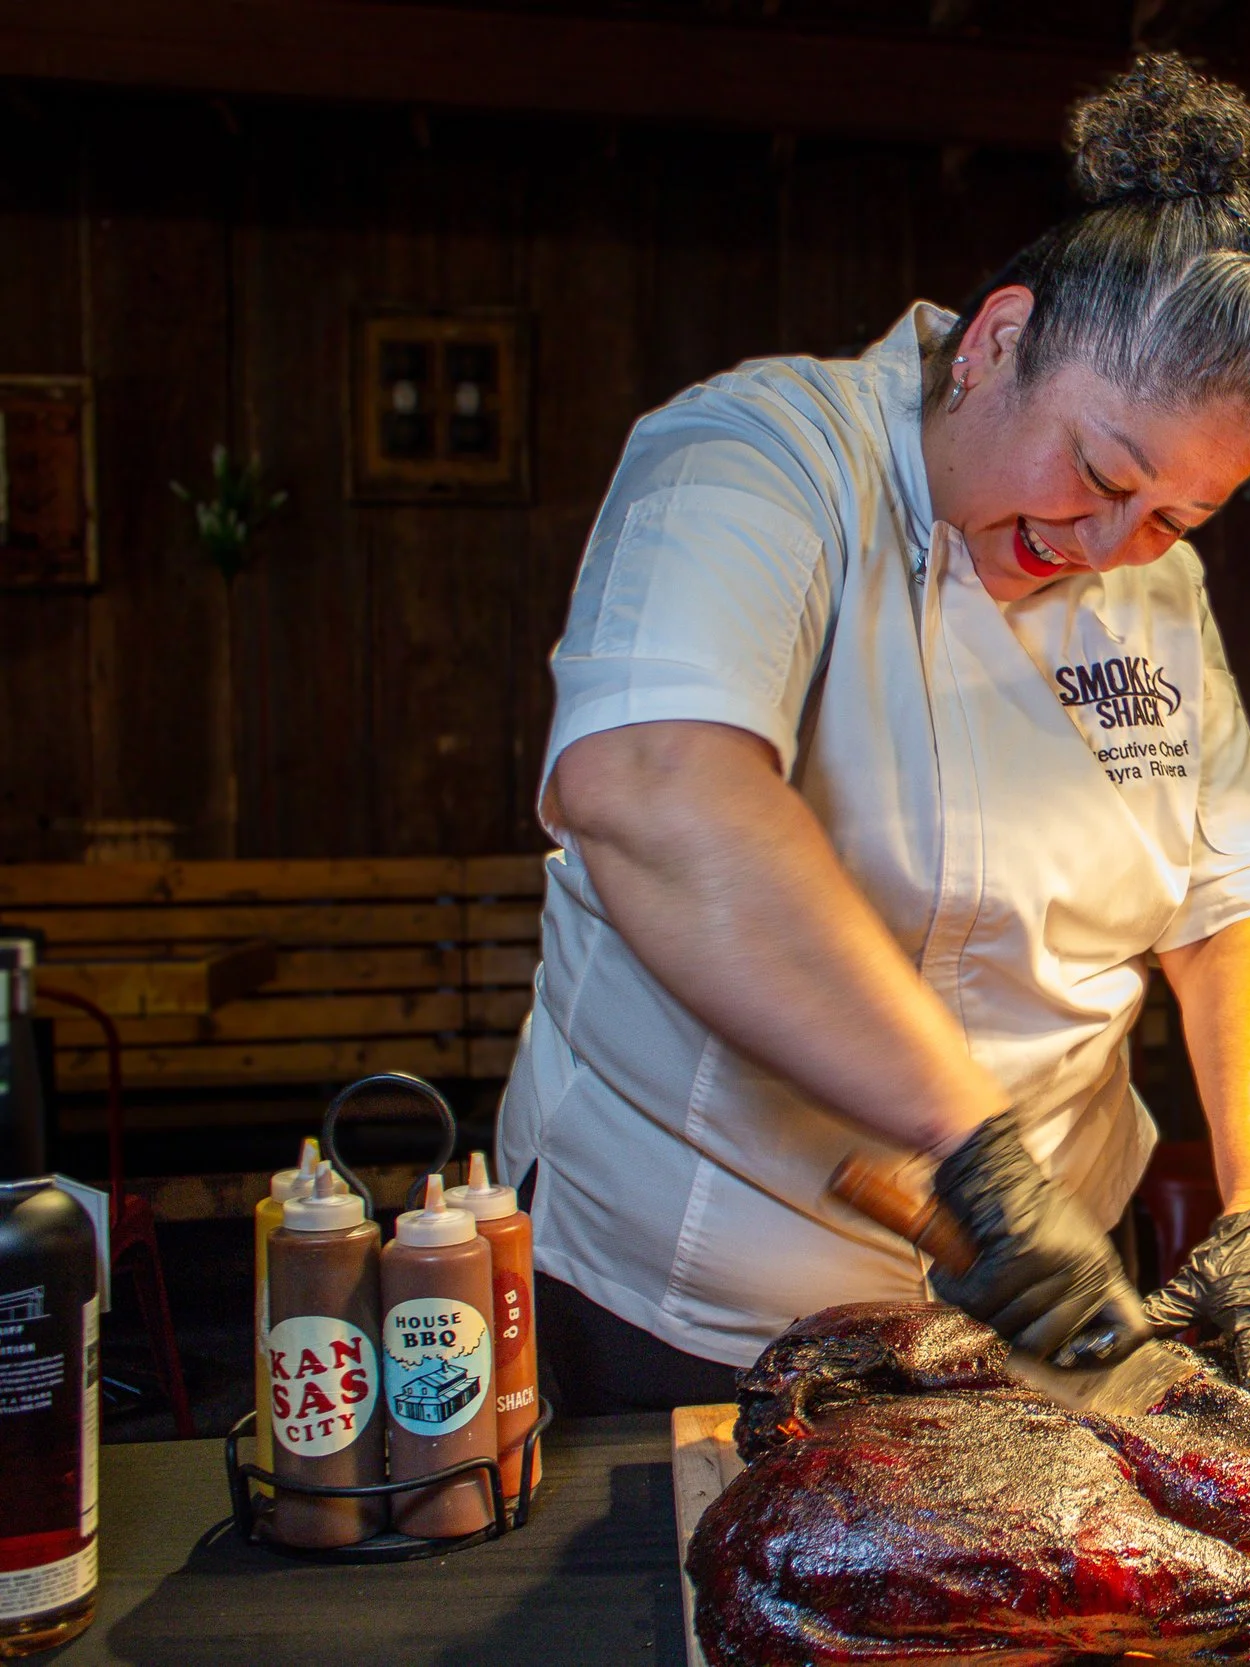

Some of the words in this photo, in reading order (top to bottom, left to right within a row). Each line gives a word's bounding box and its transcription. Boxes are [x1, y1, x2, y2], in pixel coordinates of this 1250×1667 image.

[1056, 656, 1160, 703] SMOKE
[1096, 696, 1164, 729] SHACK
[1094, 742, 1157, 762] ecutive
[1160, 740, 1189, 757] Chef
[1105, 765, 1142, 784] ayra
[1150, 760, 1187, 778] Rivera
[395, 1312, 462, 1328] HOUSE
[503, 1289, 520, 1338] BBQ
[402, 1330, 456, 1348] BBQ
[269, 1337, 362, 1380] KAN
[273, 1368, 369, 1419] SAS
[496, 1386, 534, 1413] SHACK
[286, 1413, 355, 1442] CITY
